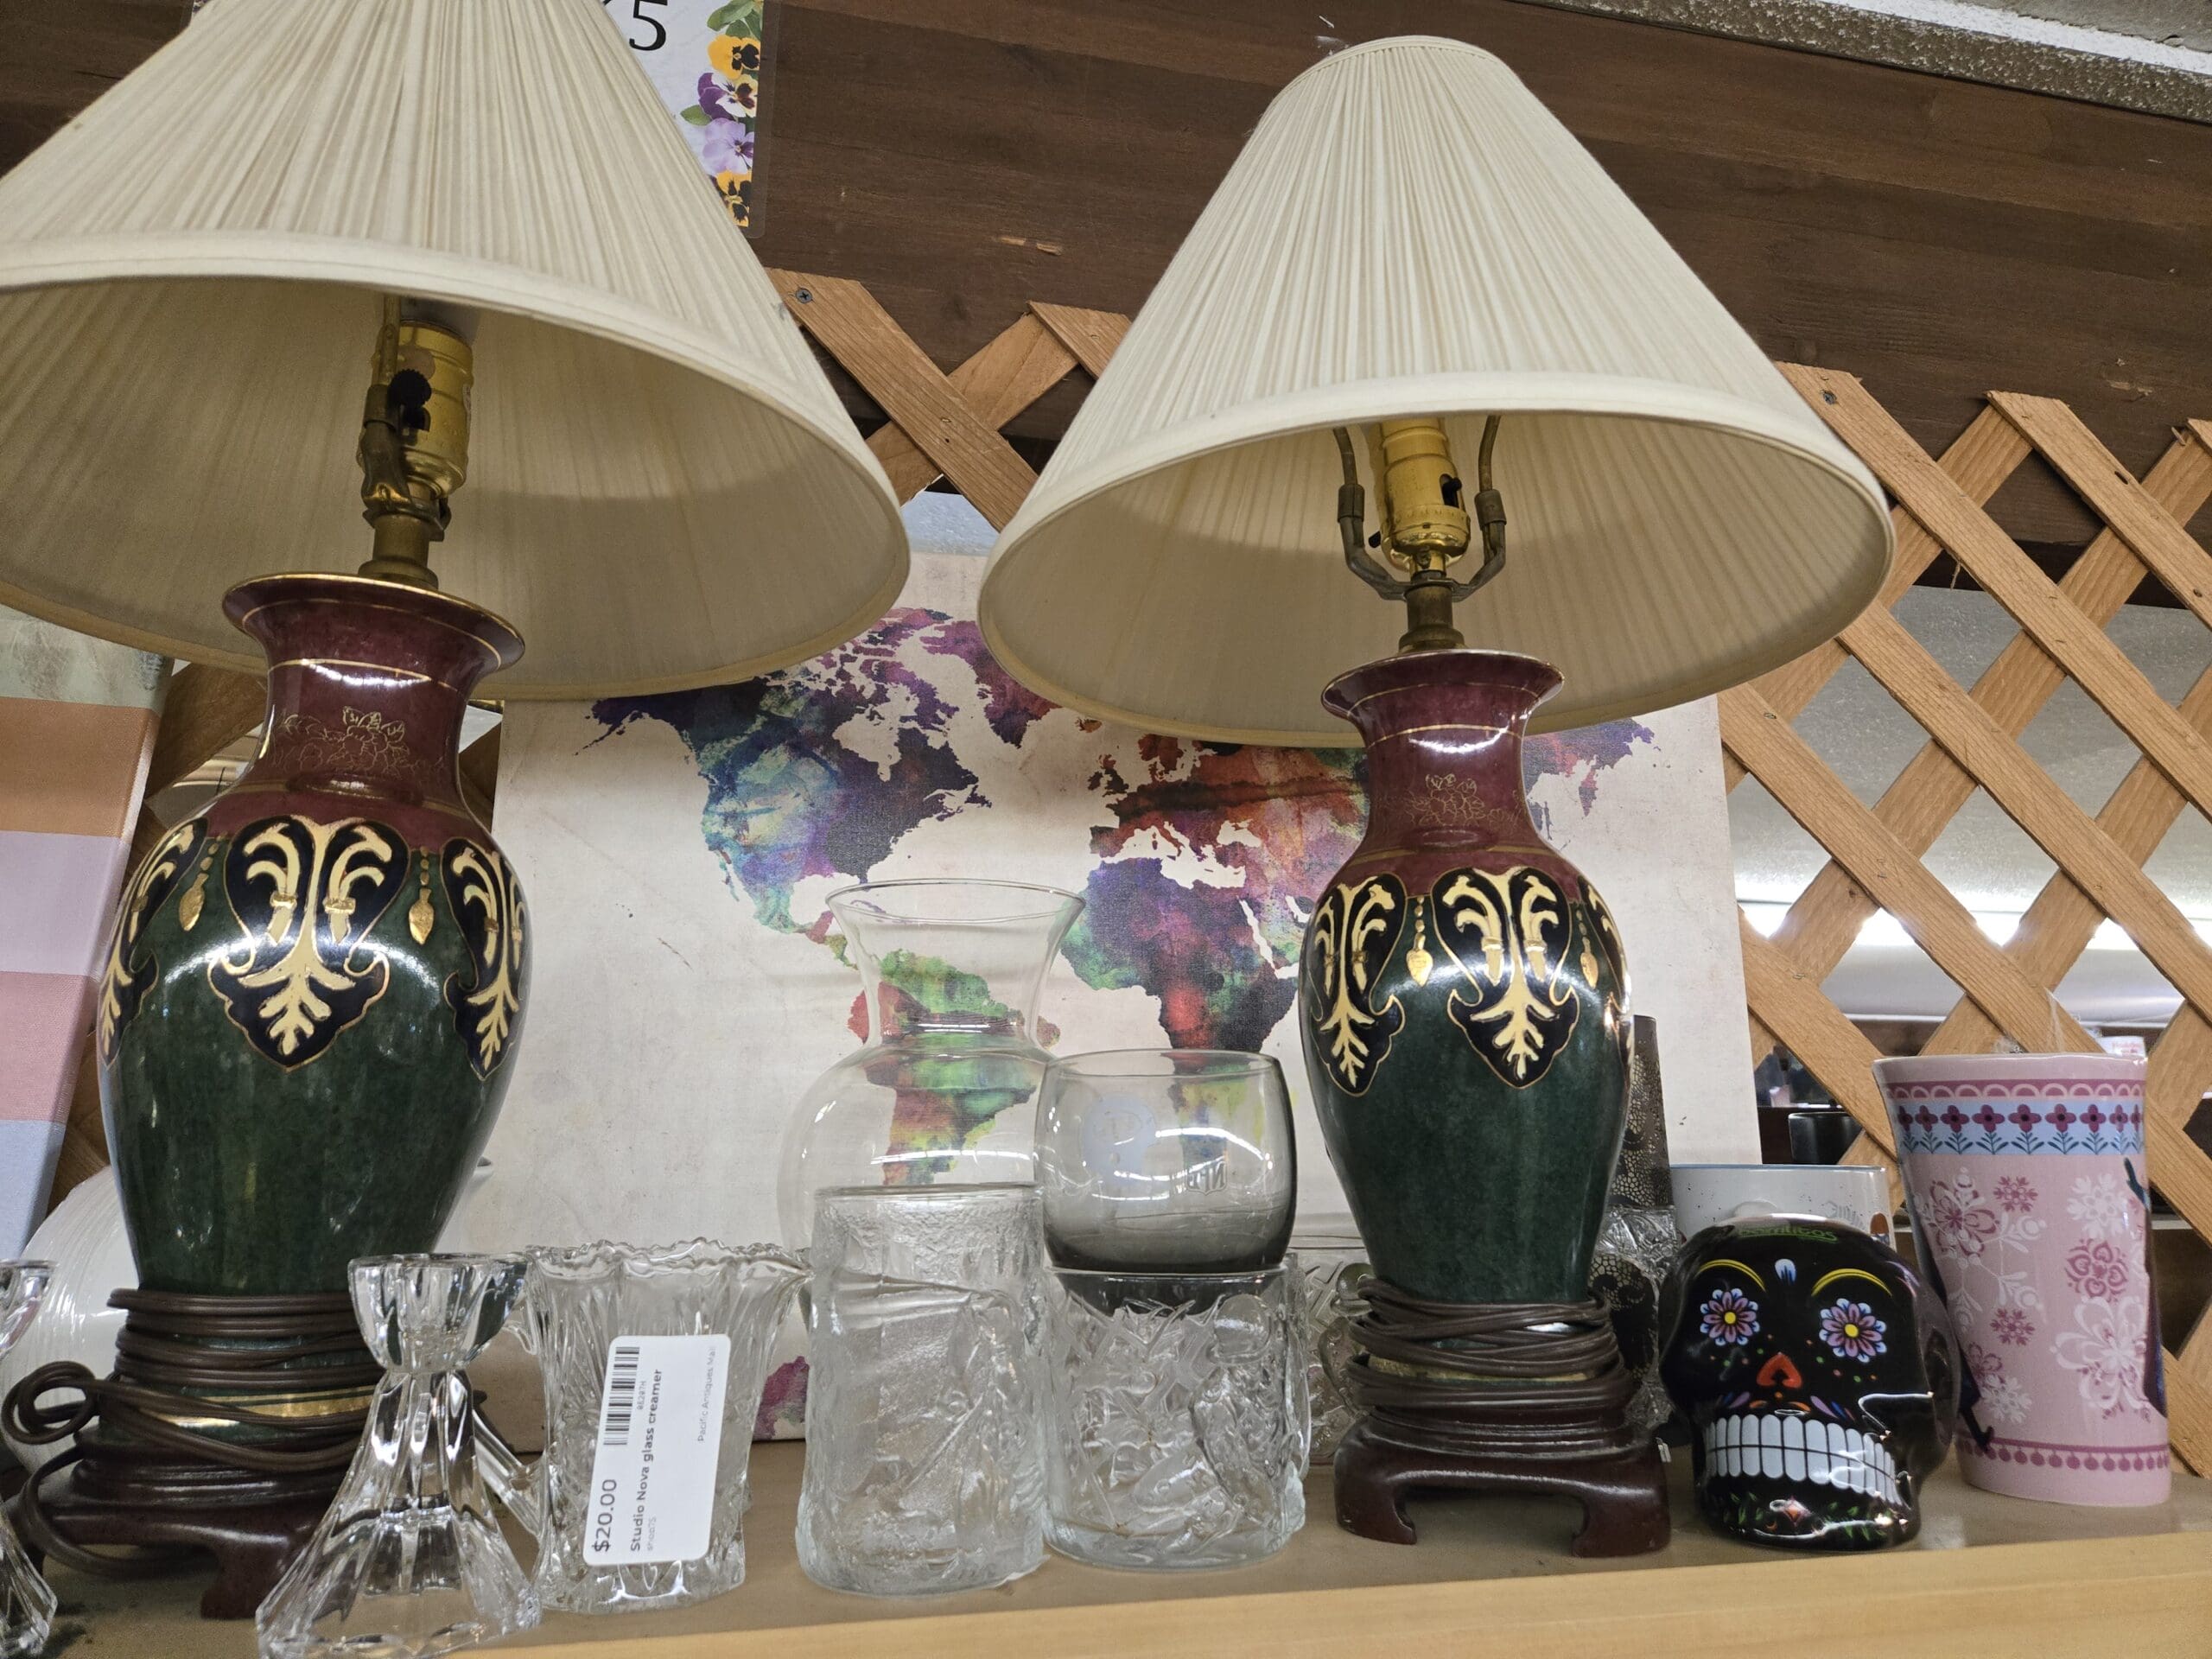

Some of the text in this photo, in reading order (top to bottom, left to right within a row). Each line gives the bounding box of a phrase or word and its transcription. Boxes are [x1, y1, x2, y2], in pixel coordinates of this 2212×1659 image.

[603, 0, 668, 51] 5
[702, 1368, 715, 1409] Antiques
[697, 1410, 709, 1442] Pacific
[631, 1370, 663, 1552] Studio Nova glass creamer
[592, 1478, 618, 1553] $20.00
